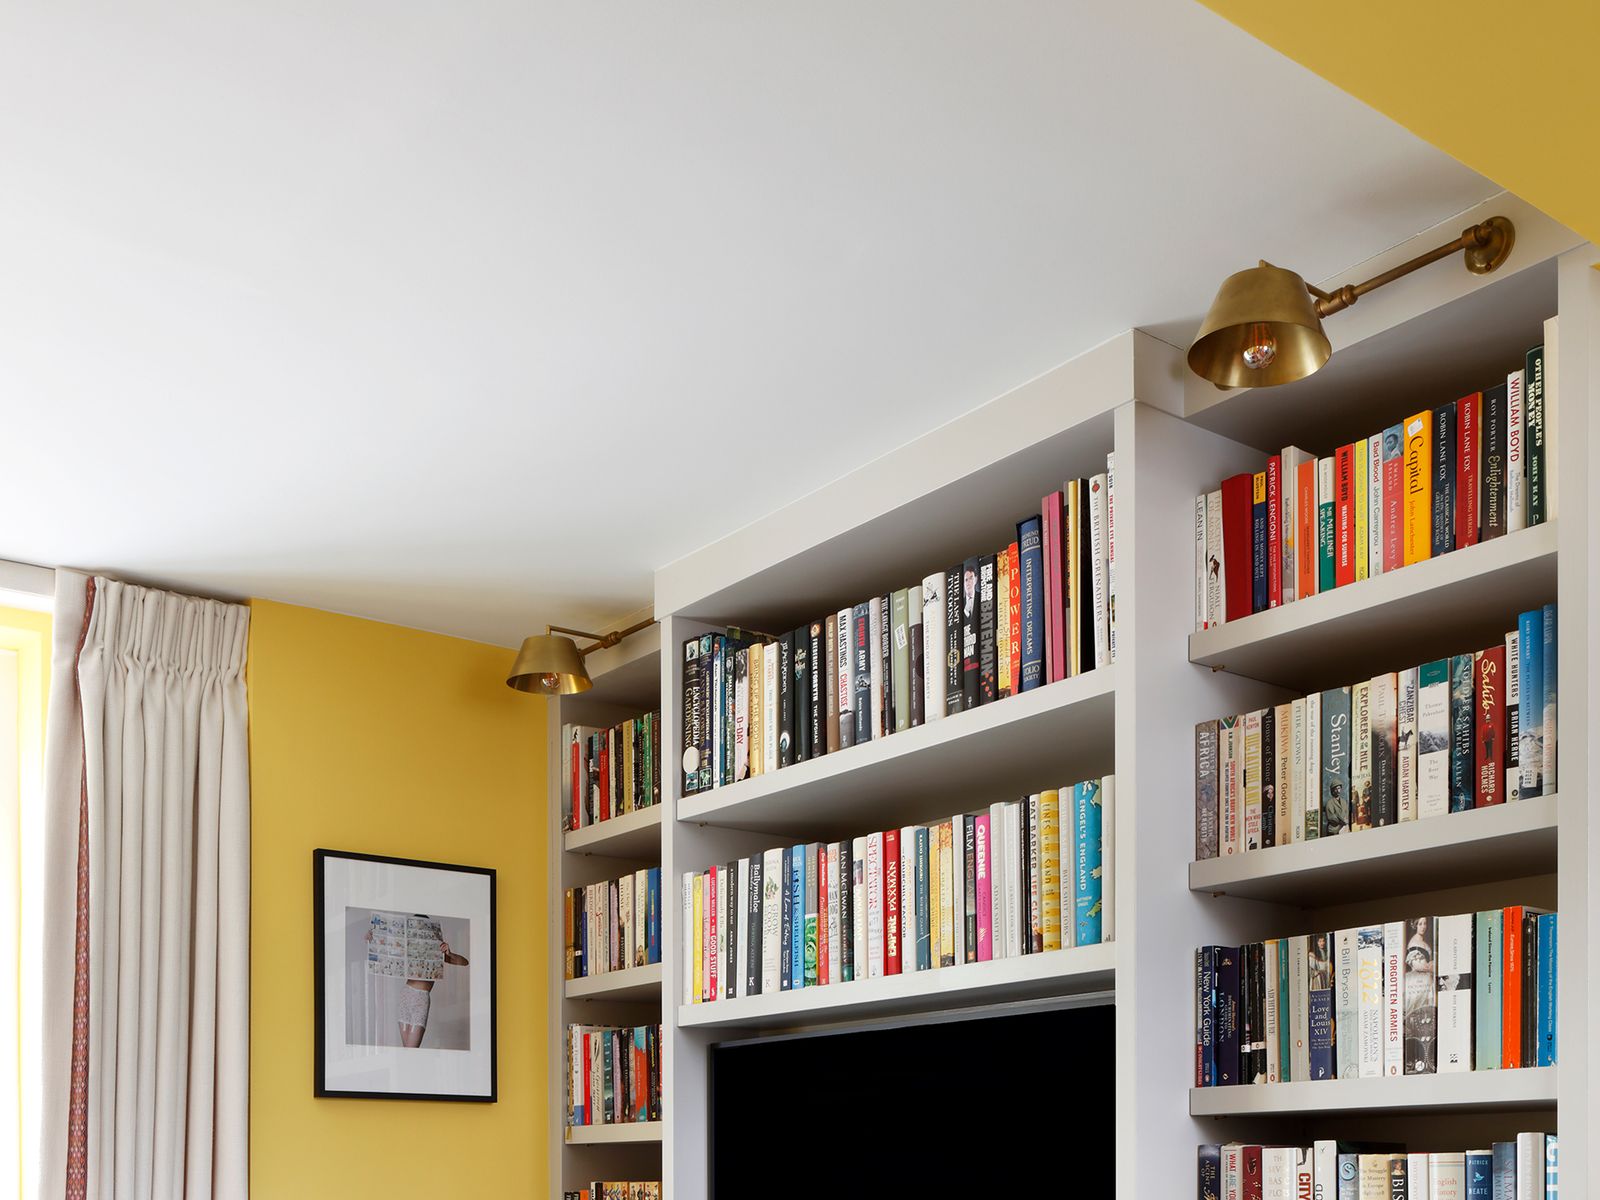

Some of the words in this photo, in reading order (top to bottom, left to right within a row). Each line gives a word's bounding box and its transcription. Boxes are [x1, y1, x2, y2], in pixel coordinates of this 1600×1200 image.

[1535, 358, 1543, 397] OTHER
[1510, 378, 1520, 426] WILLIAM
[1535, 398, 1543, 447] PEOPLE'S
[1510, 430, 1520, 462] BOYD
[1406, 436, 1423, 495] Capital
[1485, 455, 1500, 527] Enlightenment
[1093, 514, 1102, 555] BRITISH
[1197, 530, 1202, 540] IN
[1388, 538, 1397, 560] Levy
[1025, 558, 1033, 618] INTERPRETING
[1094, 558, 1103, 622] GRENADIERS
[981, 600, 993, 676] BATEMAN
[858, 650, 866, 672] ARMY
[1378, 684, 1386, 709] PAUL
[1462, 665, 1470, 712] SOLDIER
[1481, 659, 1496, 715] Sahib
[692, 686, 700, 745] ENCYCLOPEDIA
[1360, 686, 1369, 741] EXPLORERS
[1398, 700, 1406, 726] CHEST
[736, 717, 744, 745] D-DAY
[1281, 710, 1289, 754] MUKIWA
[1325, 714, 1346, 774] Stanley
[1462, 716, 1470, 755] SAHIBS
[1200, 732, 1209, 777] AFRICA
[1265, 745, 1272, 755] of
[1360, 751, 1368, 771] NILE
[1265, 757, 1273, 782] Stone
[1280, 757, 1288, 780] Peter
[1480, 765, 1488, 793] HOLMES
[1281, 783, 1289, 816] Godwin
[977, 825, 986, 880] QUEENIE
[868, 836, 877, 909] SPECTATOR
[1342, 949, 1351, 965] Bill
[1203, 971, 1211, 993] New
[1341, 969, 1351, 1006] Bryson
[1390, 955, 1398, 1005] FORGOTTEN
[1203, 995, 1211, 1015] York
[1312, 1005, 1329, 1013] Love
[1314, 1012, 1328, 1020] and
[1203, 1018, 1211, 1046] Guide
[1314, 1028, 1328, 1036] XIV
[1390, 1009, 1398, 1042] ARMIES
[1201, 1168, 1205, 1177] OF
